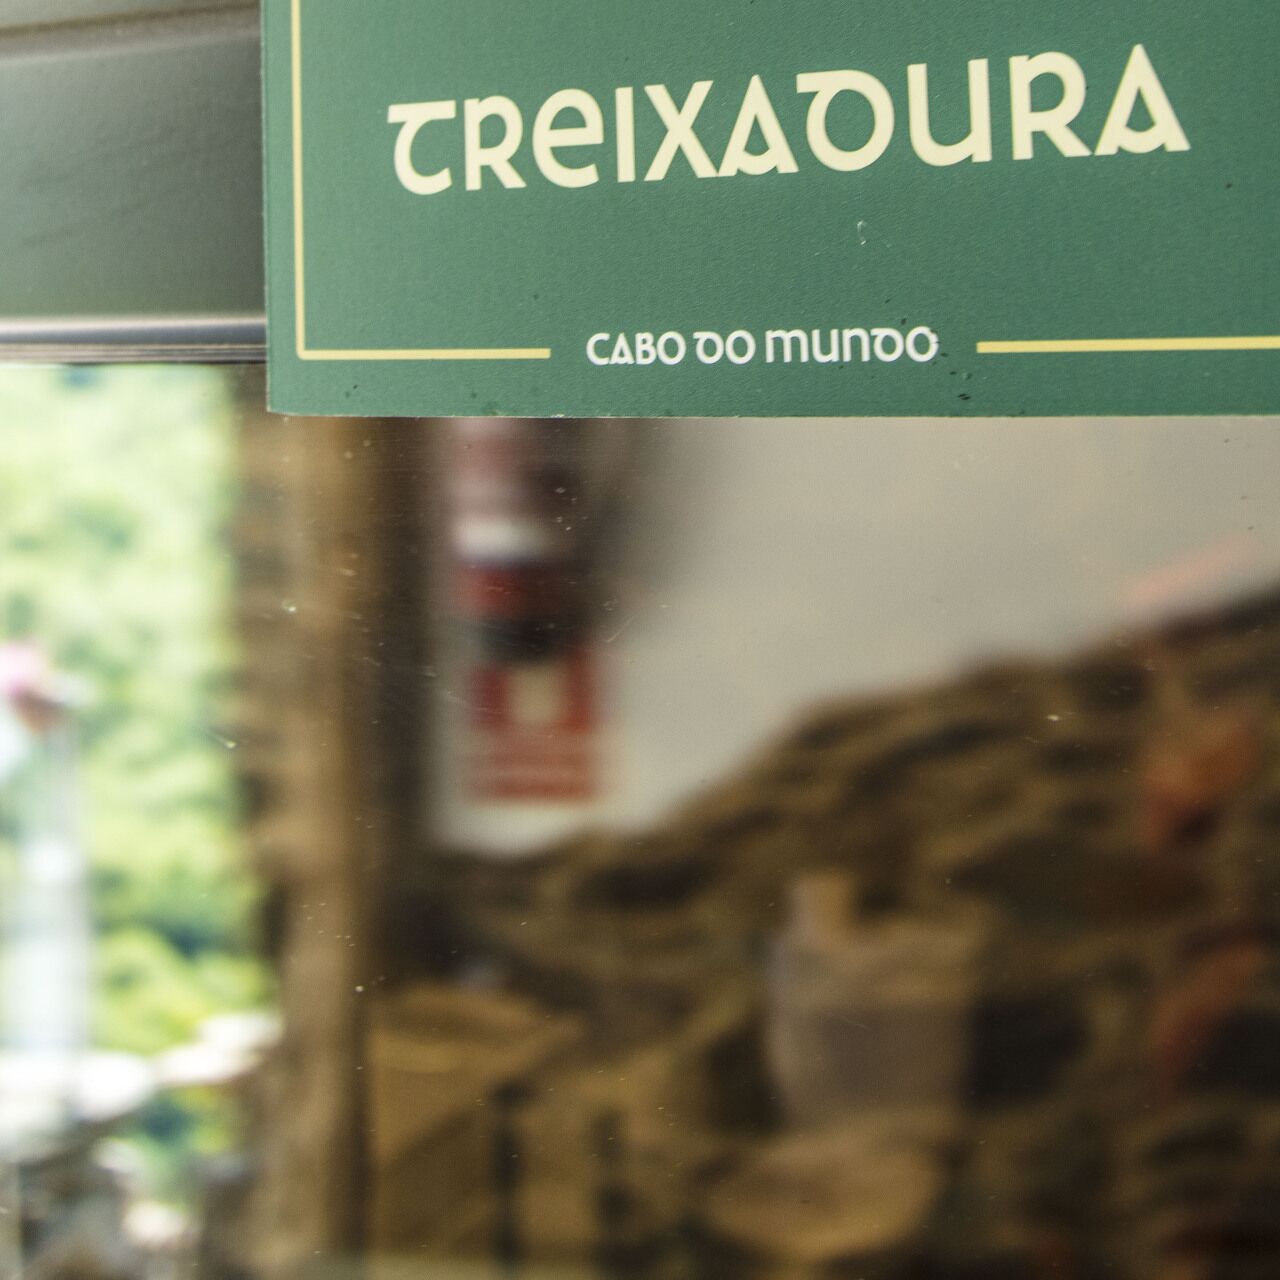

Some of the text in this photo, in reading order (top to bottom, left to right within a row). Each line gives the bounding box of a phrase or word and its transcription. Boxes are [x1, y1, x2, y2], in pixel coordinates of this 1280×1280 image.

[387, 43, 1191, 195] TREIXADURA
[585, 330, 687, 366] CABO
[692, 329, 757, 365] DO
